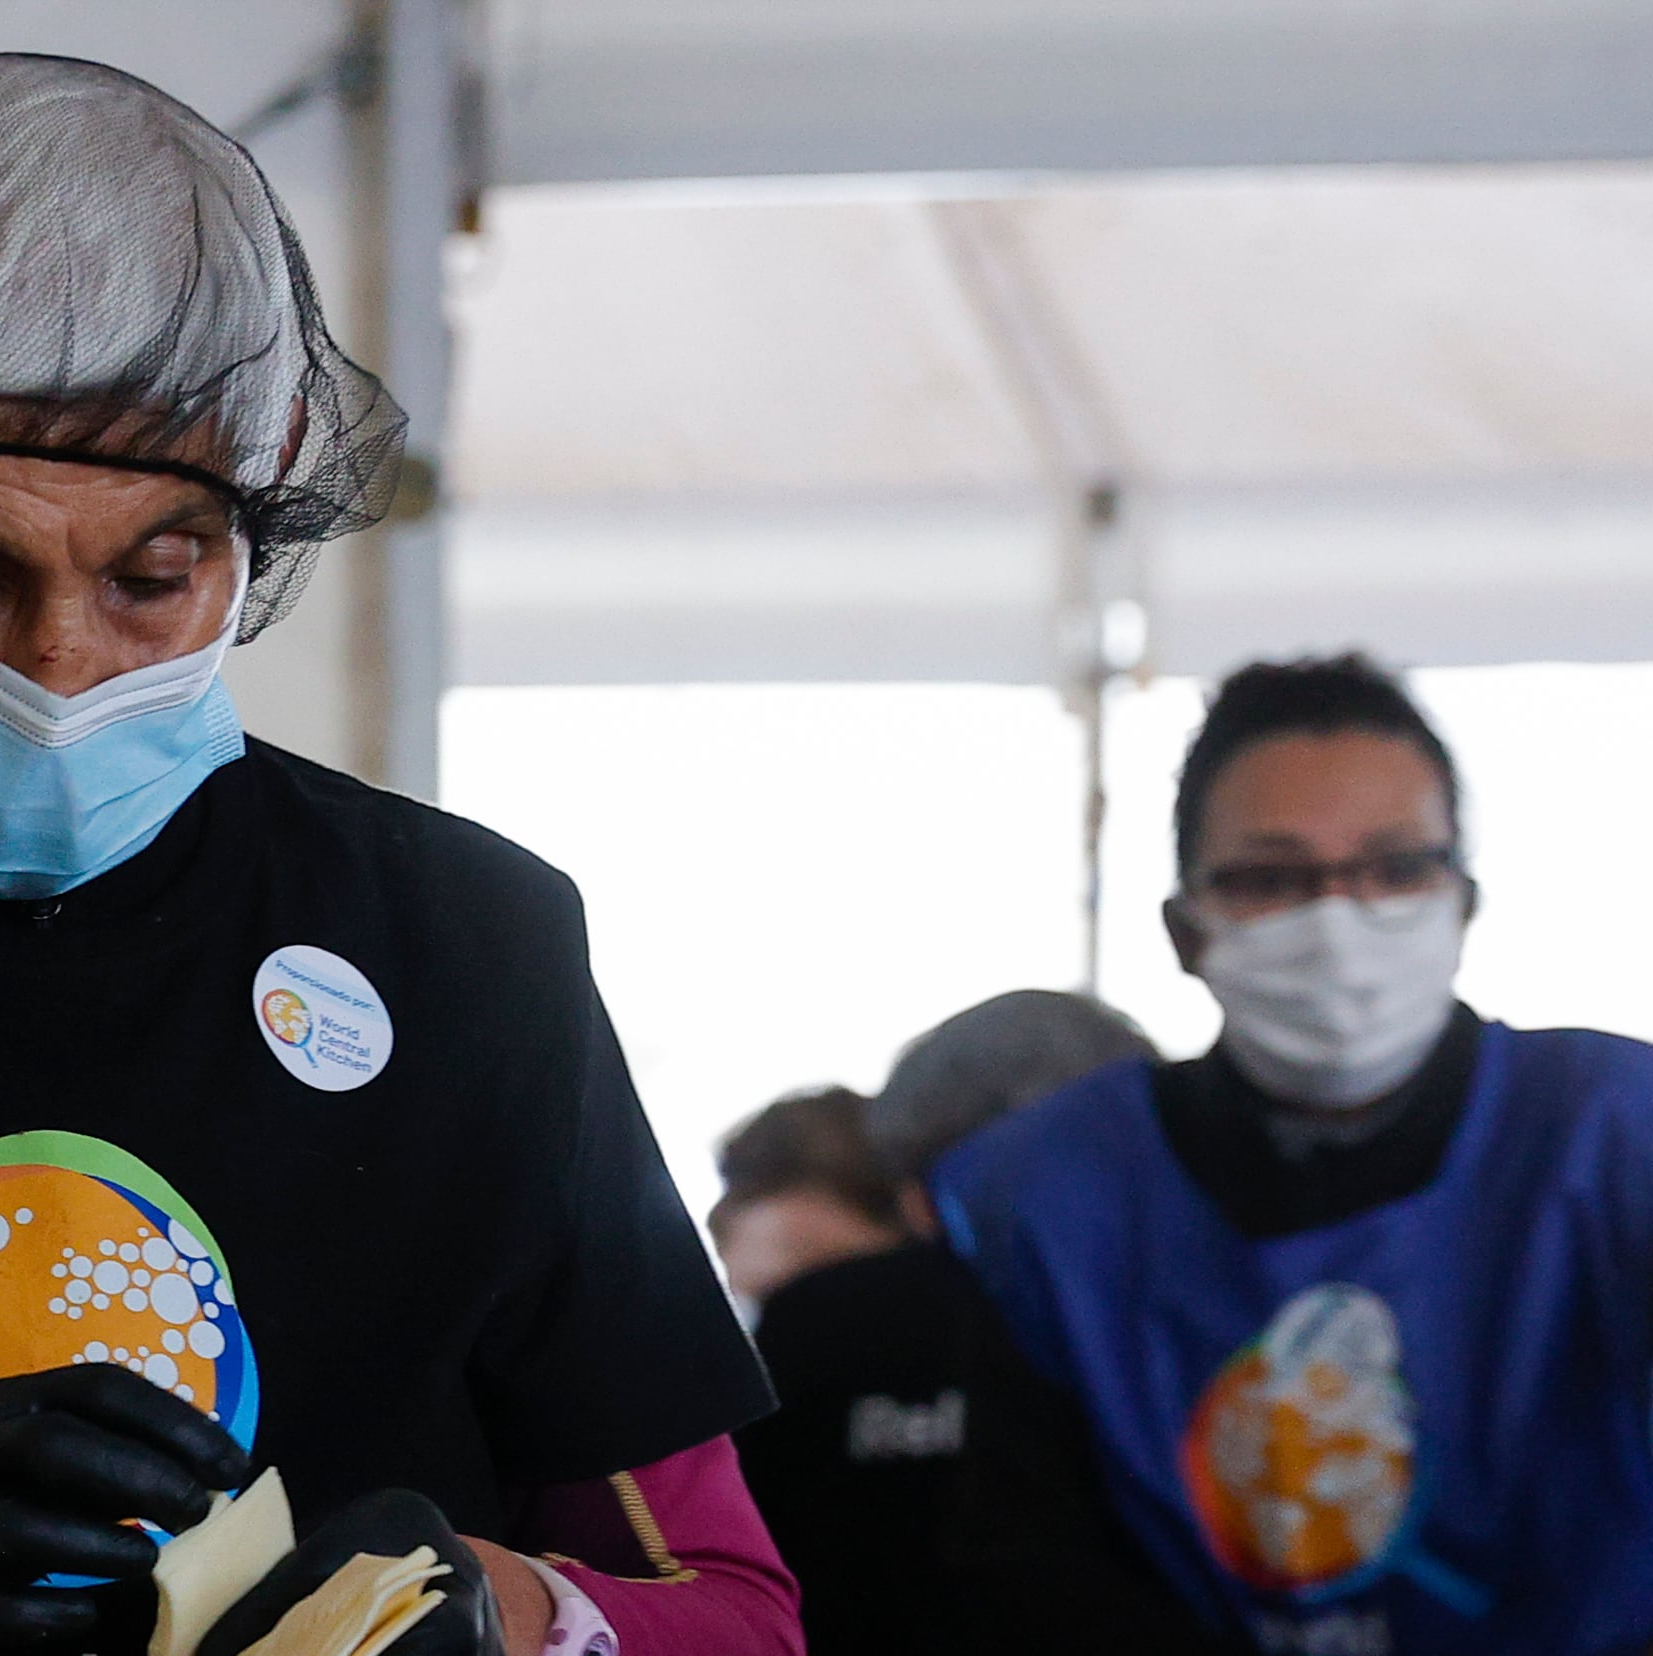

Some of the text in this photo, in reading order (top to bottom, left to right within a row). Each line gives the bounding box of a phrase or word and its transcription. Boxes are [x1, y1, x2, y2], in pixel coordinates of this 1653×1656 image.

[320, 1015, 359, 1040] World
[320, 1031, 370, 1057] Central
[317, 1046, 371, 1073] Kitchen
